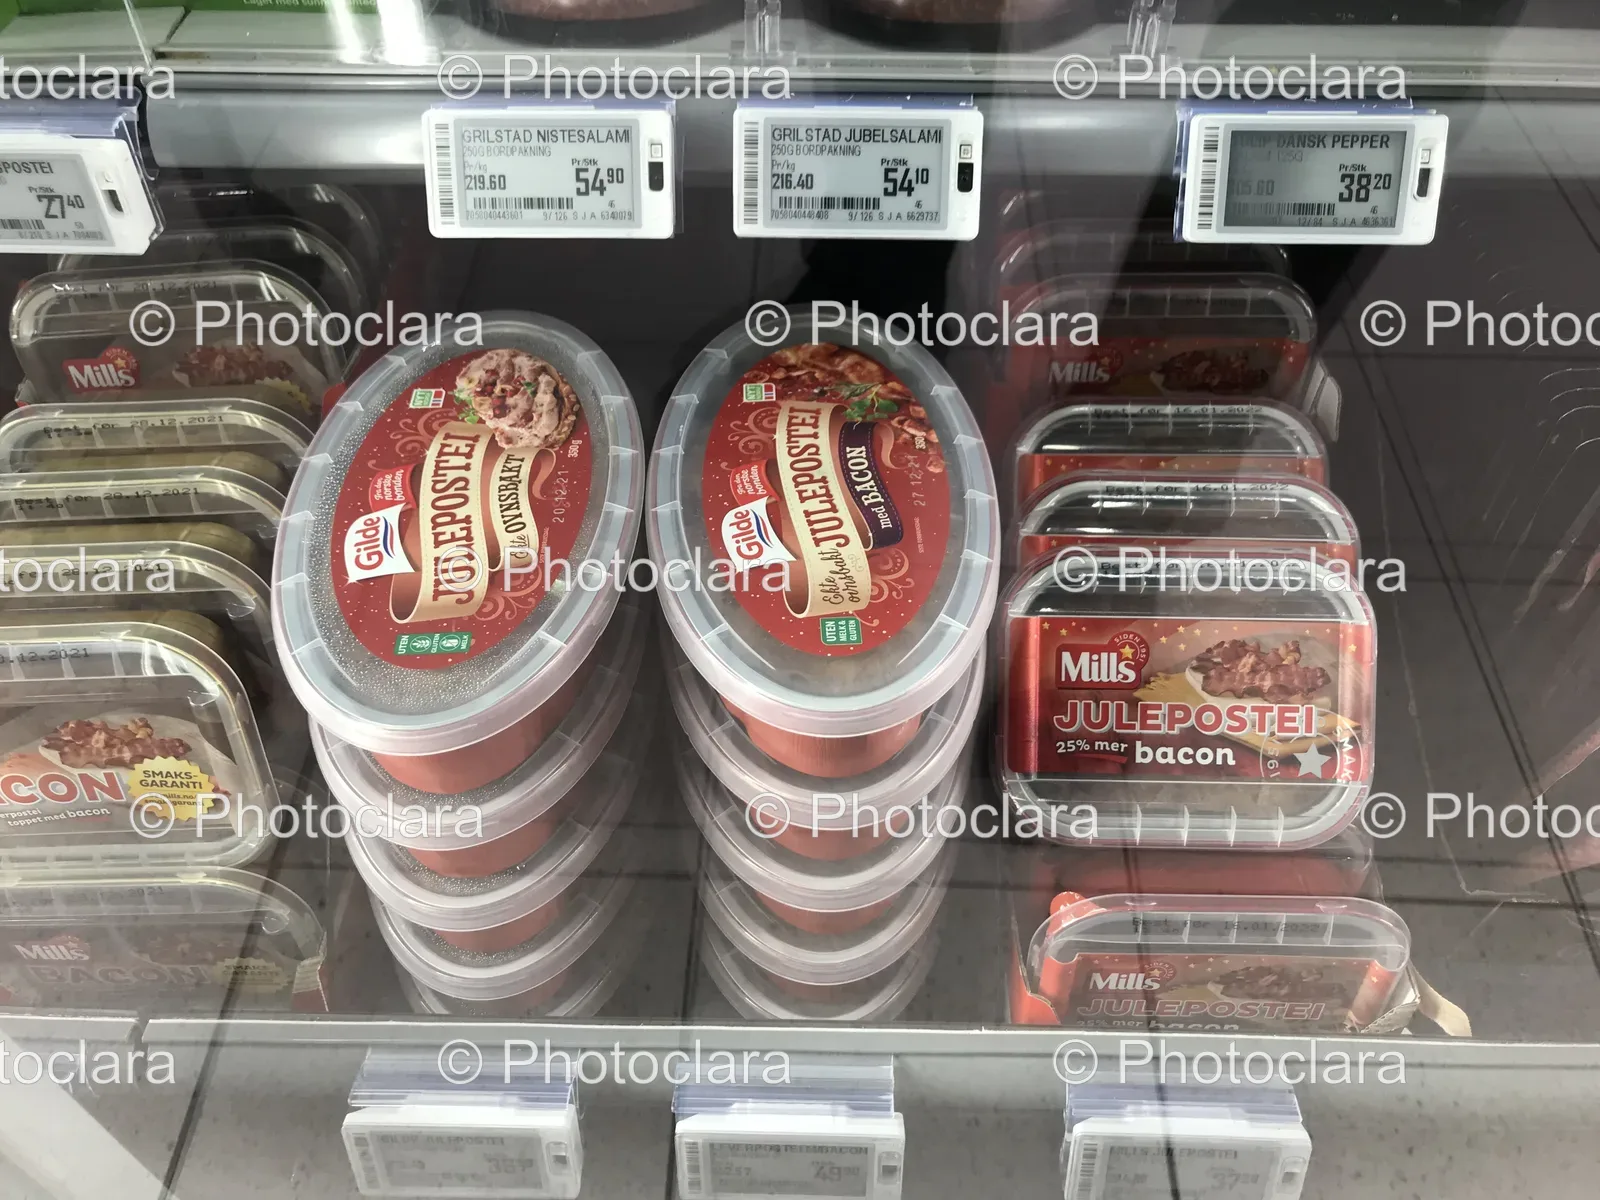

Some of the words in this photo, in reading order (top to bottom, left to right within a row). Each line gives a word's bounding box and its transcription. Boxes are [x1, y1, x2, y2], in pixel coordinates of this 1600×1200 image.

[462, 129, 533, 144] GRILSTAD
[537, 129, 630, 144] NISTESALAMI
[771, 128, 842, 143] GRILSTAD
[844, 128, 942, 144] JUBELSALAMI
[1277, 134, 1327, 149] DANSK
[1332, 134, 1390, 149] PEPPER
[486, 146, 551, 157] BORDPAKNING
[795, 145, 861, 157] BORDPAKNING
[571, 158, 598, 167] Pr/Stk
[771, 160, 796, 172] Pr/kg
[880, 158, 908, 167] Pr/Stk
[1339, 164, 1367, 172] Pr/Stk
[465, 174, 507, 190] 219.60
[771, 173, 814, 190] 216.40
[68, 364, 136, 389] Mills
[1048, 360, 1110, 384] Mills
[383, 472, 394, 501] norske
[392, 468, 406, 501] bonden
[741, 468, 756, 495] norske
[750, 464, 768, 495] bonden
[787, 406, 851, 548] JULEPOSTEI
[846, 445, 879, 507] BACON
[498, 454, 527, 534] OVNSBAKT
[430, 432, 482, 605] JULEPOSTEI
[870, 505, 893, 530] med
[354, 516, 385, 571] Gilde
[729, 508, 764, 561] Gilde
[818, 576, 845, 605] Ekte
[825, 621, 837, 642] UTEN
[838, 624, 848, 642] MELK
[848, 620, 858, 641] GLUTEN
[1114, 633, 1140, 643] SIDEN
[397, 634, 410, 655] UTEN
[430, 633, 441, 653] GLUTEN
[460, 634, 470, 650] MELK
[1061, 651, 1137, 684] Mills
[1053, 700, 1319, 737] JULEPOSTEI
[1056, 739, 1091, 753] 25%
[1094, 740, 1129, 753] mer
[1135, 741, 1236, 766] bacon
[139, 778, 203, 790] GARANTI
[142, 769, 198, 781] SMAKS-
[7, 816, 43, 827] toppet
[44, 812, 67, 822] med
[68, 807, 110, 818] bacon
[14, 944, 90, 961] Mills
[27, 964, 212, 985] BACON
[1089, 972, 1161, 990] Mills
[1077, 999, 1326, 1021] JULEPOSTEI
